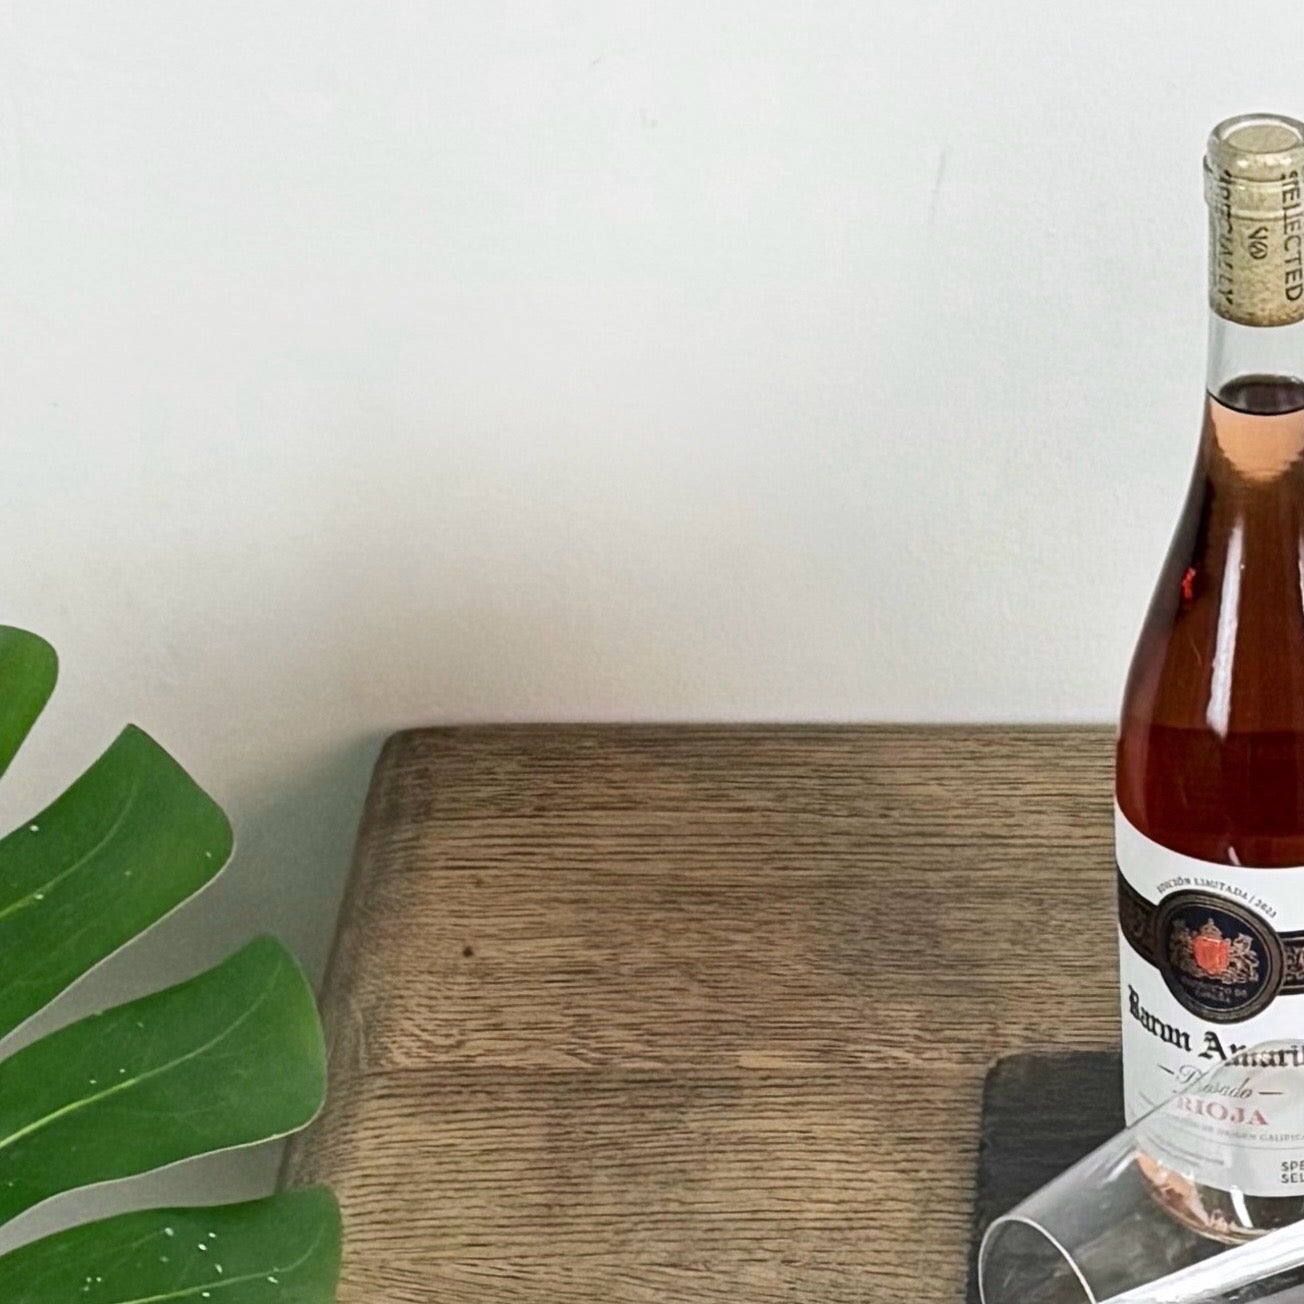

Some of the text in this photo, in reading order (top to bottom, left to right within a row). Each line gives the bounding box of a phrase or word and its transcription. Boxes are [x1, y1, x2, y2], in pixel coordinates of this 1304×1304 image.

[1194, 877, 1248, 900] LIMITADA
[1128, 984, 1193, 1052] Baron
[1177, 1096, 1269, 1126] RIOJA
